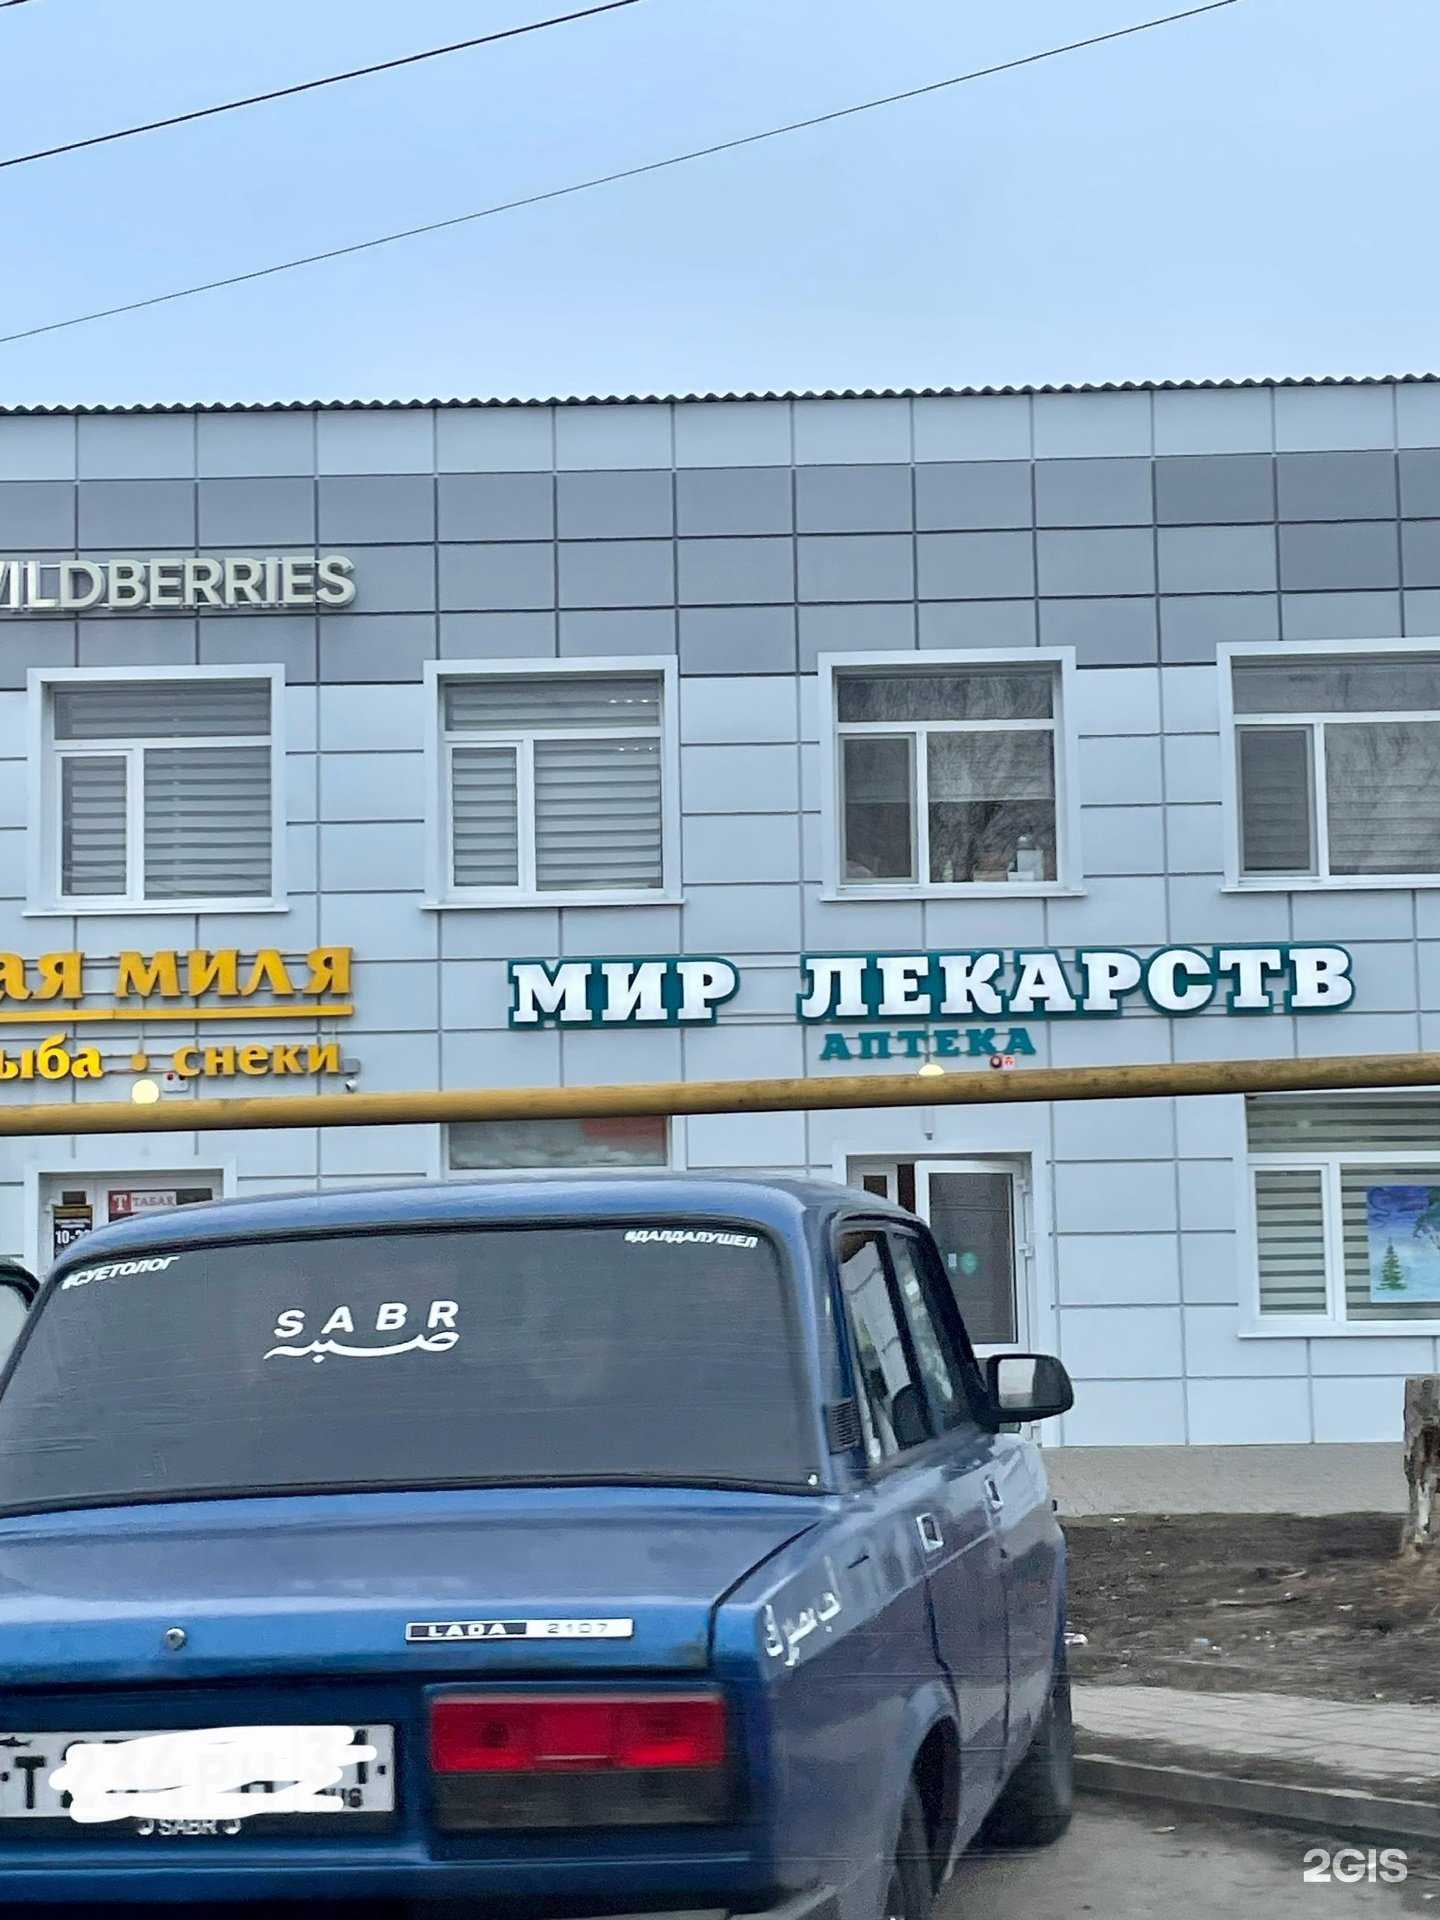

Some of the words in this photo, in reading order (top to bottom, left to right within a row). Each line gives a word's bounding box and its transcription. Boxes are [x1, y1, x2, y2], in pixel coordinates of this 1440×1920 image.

[510, 957, 738, 1025] МИР
[800, 948, 1352, 1018] ЛЕКАРСТВ
[173, 1043, 341, 1078] снеки
[819, 1028, 1036, 1061] АПТЕКА
[273, 1300, 459, 1338] SABR
[428, 1622, 508, 1638] LADA
[546, 1622, 609, 1634] 2107
